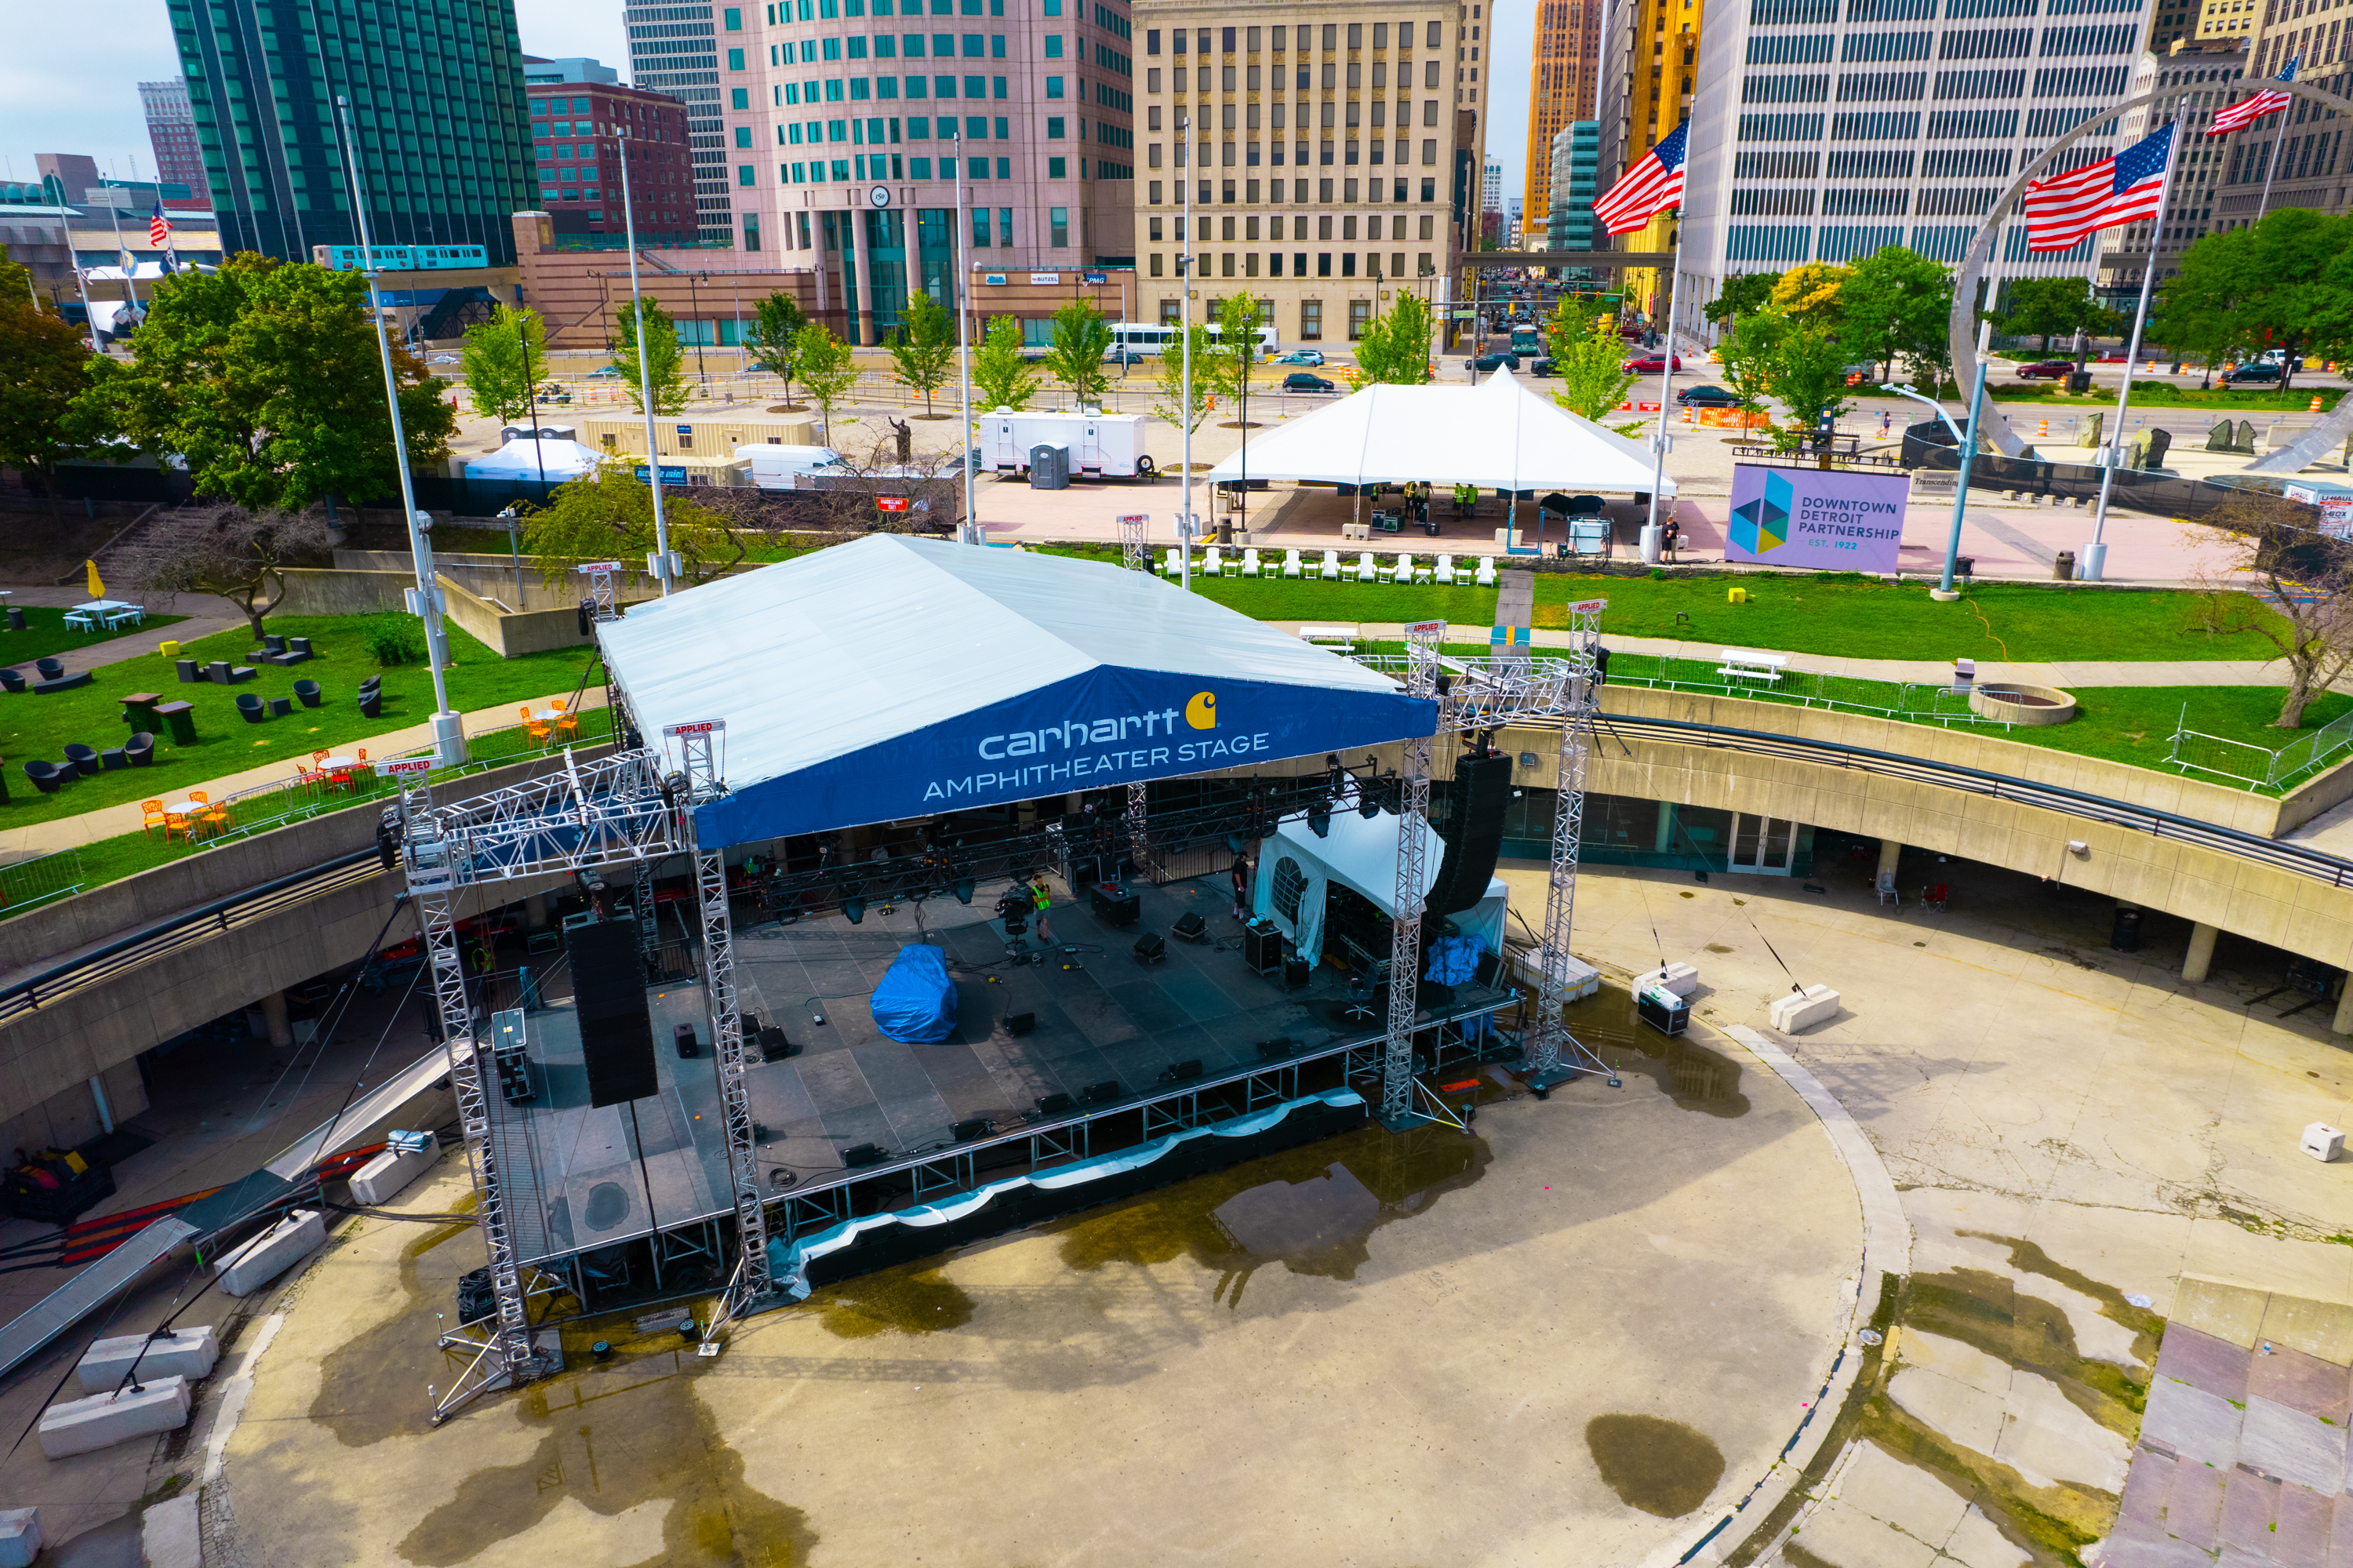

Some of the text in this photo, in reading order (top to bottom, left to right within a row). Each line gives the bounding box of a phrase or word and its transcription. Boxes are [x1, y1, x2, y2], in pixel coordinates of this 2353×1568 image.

[665, 469, 685, 478] mini
[1802, 497, 1897, 514] DOWNTOWN
[1800, 509, 1864, 524] DETROIT
[1798, 522, 1900, 540] PARTNERSHIP
[1809, 539, 1857, 550] EST. 1922
[1577, 602, 1600, 611] APPLIED
[1413, 623, 1438, 632] APPLIED
[675, 722, 712, 734] APPLIED
[978, 708, 1180, 760] carhartt
[388, 760, 431, 773] APPLIED
[922, 747, 1169, 802] AMPHITHEATER
[1177, 732, 1270, 762] STAGE
